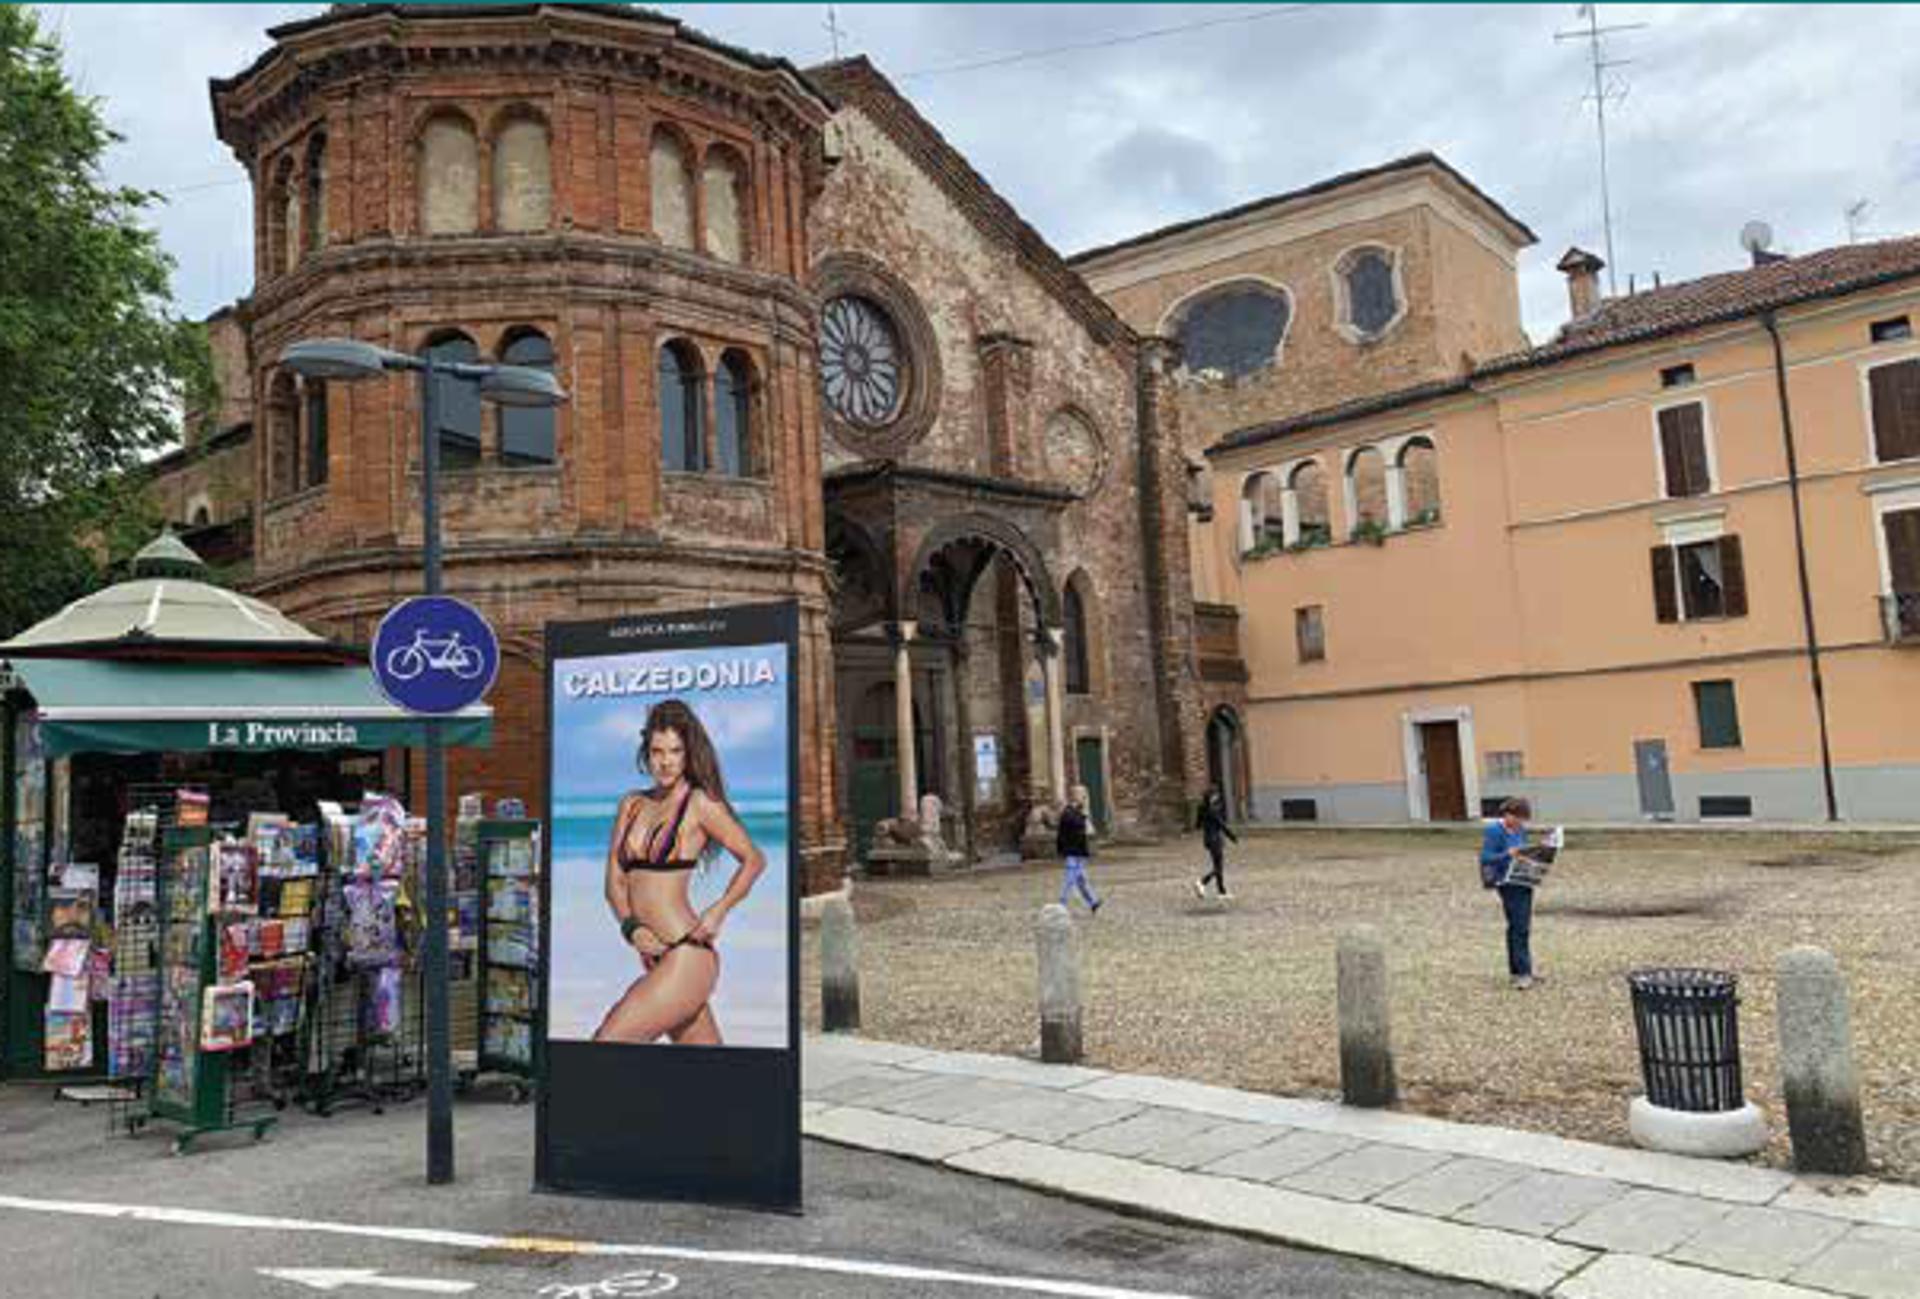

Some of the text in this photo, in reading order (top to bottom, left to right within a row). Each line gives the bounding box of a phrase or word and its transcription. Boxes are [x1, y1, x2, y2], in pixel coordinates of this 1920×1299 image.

[564, 659, 775, 697] CALZEDONIA
[208, 721, 358, 745] La Provincia
